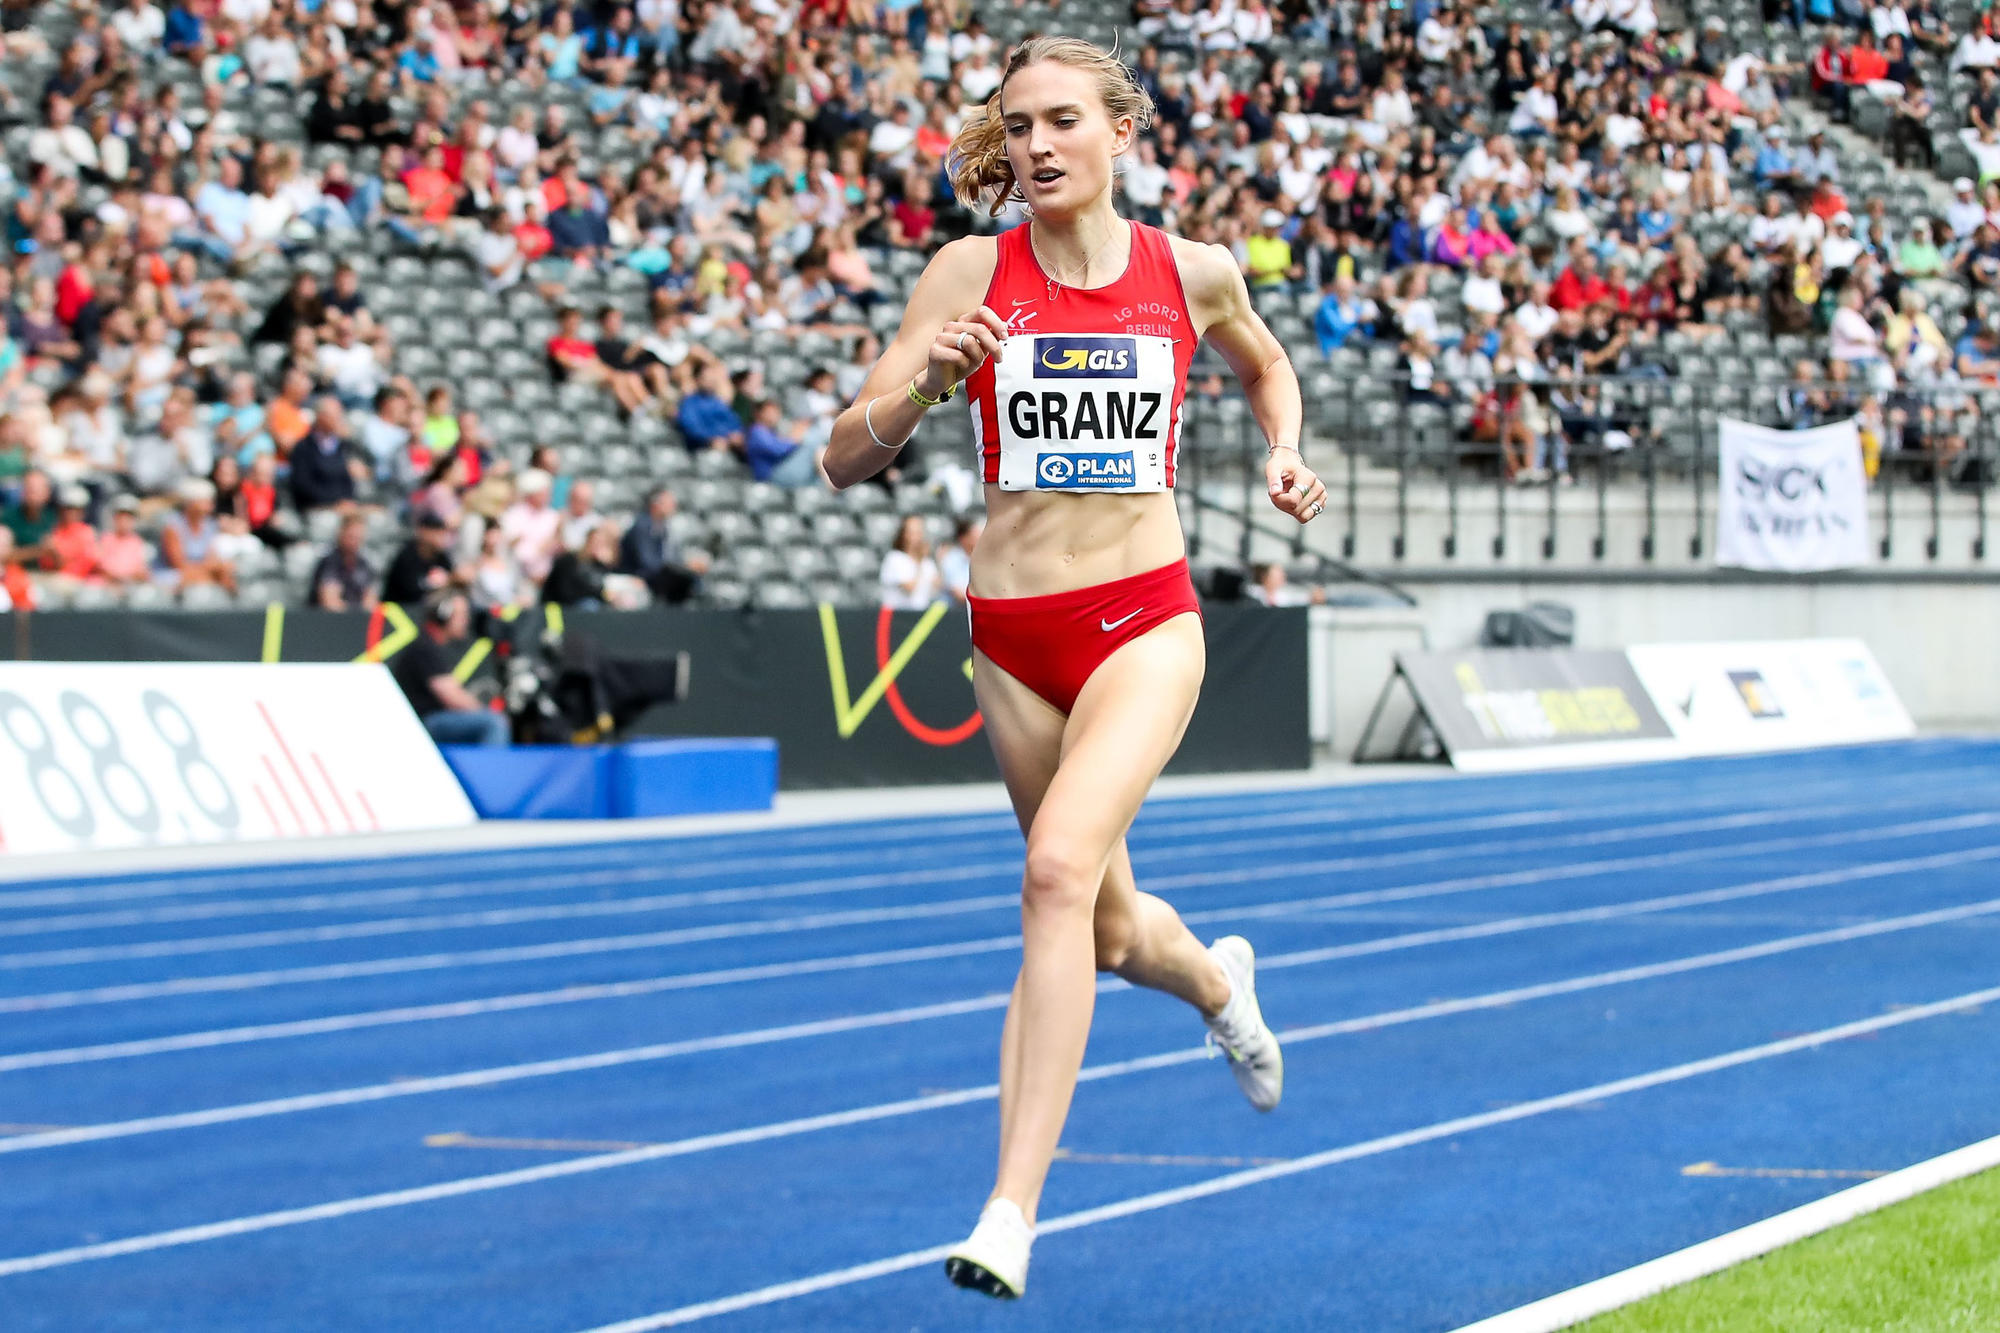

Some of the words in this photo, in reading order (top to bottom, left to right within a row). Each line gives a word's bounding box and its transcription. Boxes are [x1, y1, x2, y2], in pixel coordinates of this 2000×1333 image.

[1113, 307, 1133, 323] LG
[1137, 302, 1179, 322] NORD
[1126, 324, 1172, 336] BERLIN
[1088, 349, 1129, 371] GLS
[1008, 391, 1162, 440] GRANZ
[1077, 458, 1133, 475] PLAN
